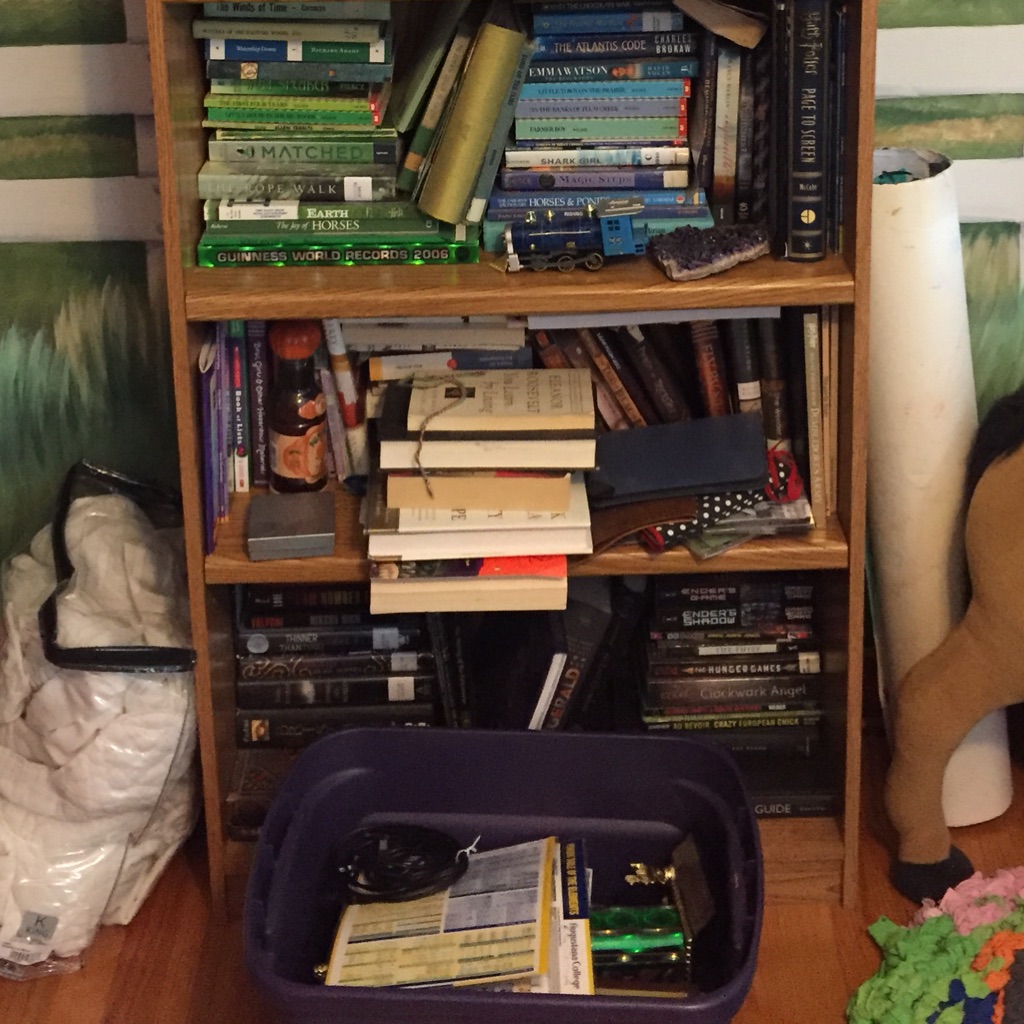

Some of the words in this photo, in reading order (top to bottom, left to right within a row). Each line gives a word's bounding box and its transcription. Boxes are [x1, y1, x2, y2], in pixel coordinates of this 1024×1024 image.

[554, 43, 571, 53] THE
[575, 41, 619, 52] ATLANTIS
[622, 40, 646, 51] CODE
[801, 88, 816, 110] PAGE
[802, 115, 815, 126] TO
[801, 130, 816, 163] SCREEN
[261, 146, 362, 159] MATCHED
[307, 208, 348, 218] EARTH
[217, 252, 287, 262] GUINNESS
[292, 252, 340, 261] WORLD
[347, 251, 407, 260] RECORDS
[683, 617, 735, 626] SHADOW
[708, 664, 748, 672] HUNGER
[751, 664, 780, 672] GAMES
[755, 804, 791, 814] GUIDE
